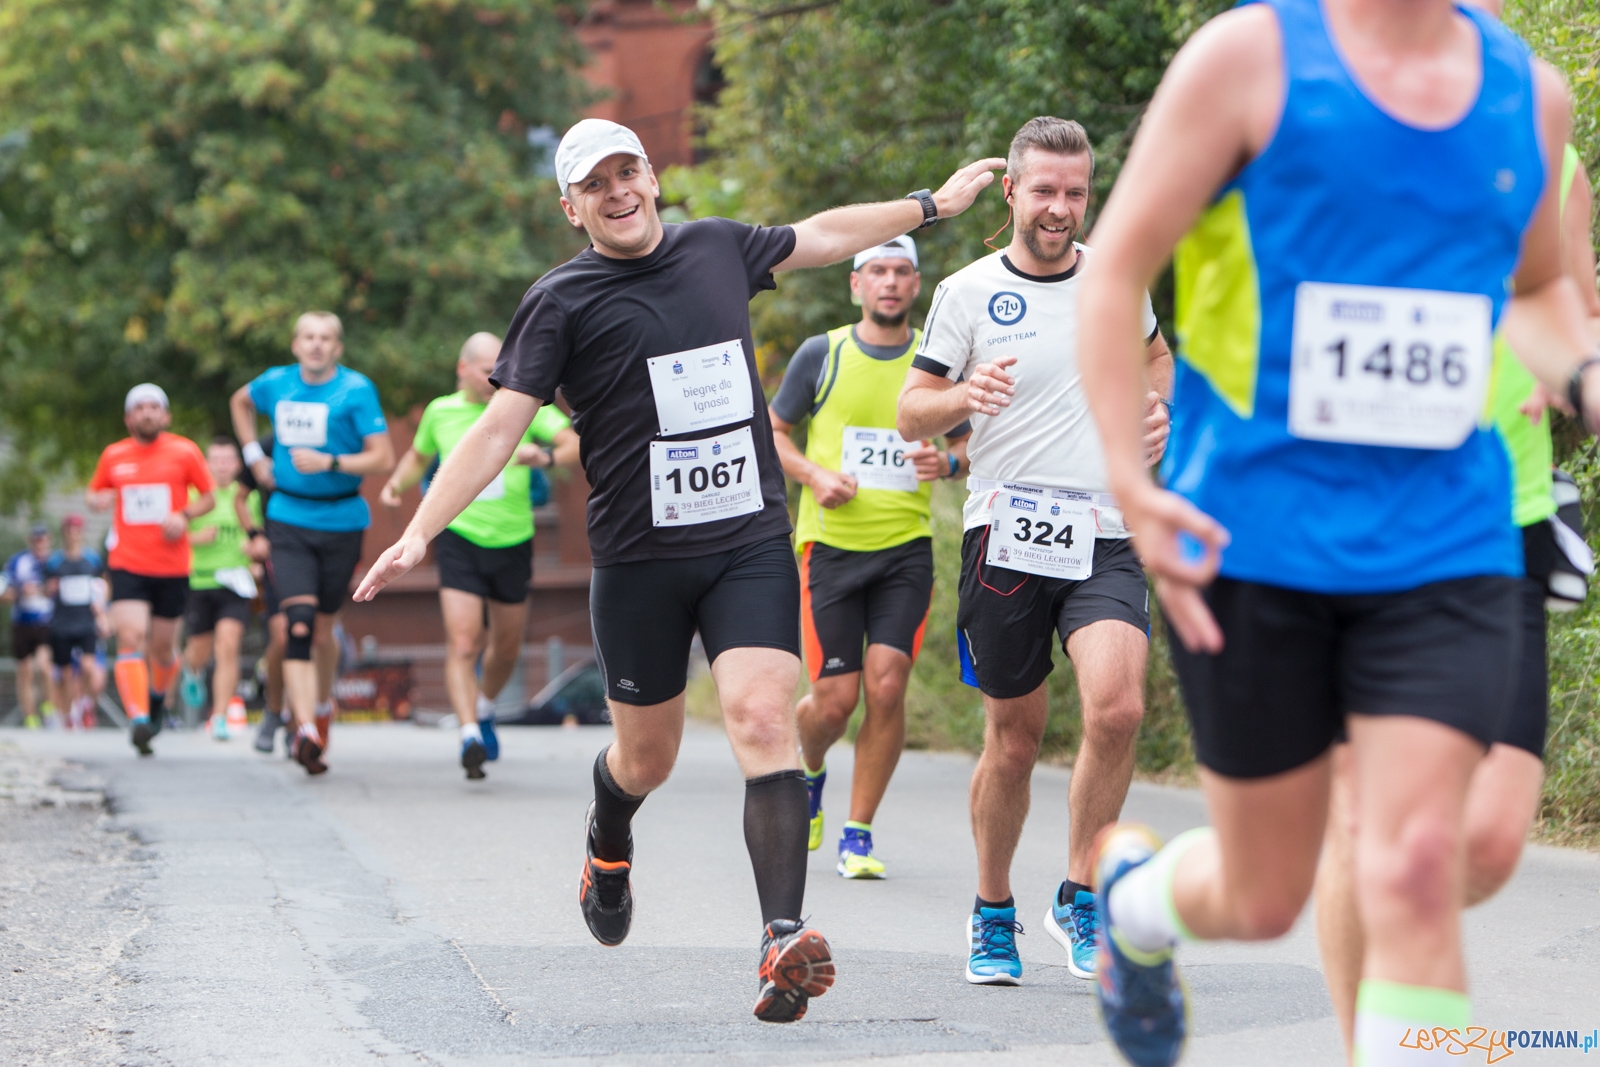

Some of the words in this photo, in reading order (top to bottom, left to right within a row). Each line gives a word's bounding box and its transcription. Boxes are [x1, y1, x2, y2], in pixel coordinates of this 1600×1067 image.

[997, 300, 1018, 316] PZU
[987, 335, 1012, 346] SPORT
[1014, 331, 1037, 341] TEAM
[1323, 338, 1467, 386] 1486
[683, 384, 717, 398] biegnę
[719, 379, 732, 391] dla
[693, 396, 730, 413] Ignasia
[860, 447, 905, 467] 216
[666, 455, 746, 494] 1067
[681, 502, 692, 511] 39
[694, 499, 713, 509] BIEG
[715, 489, 752, 505] LECHITÓW
[1013, 517, 1074, 549] 324
[1013, 548, 1023, 557] 39
[1024, 551, 1042, 560] BIEG
[1044, 555, 1082, 565] LECHITÓW
